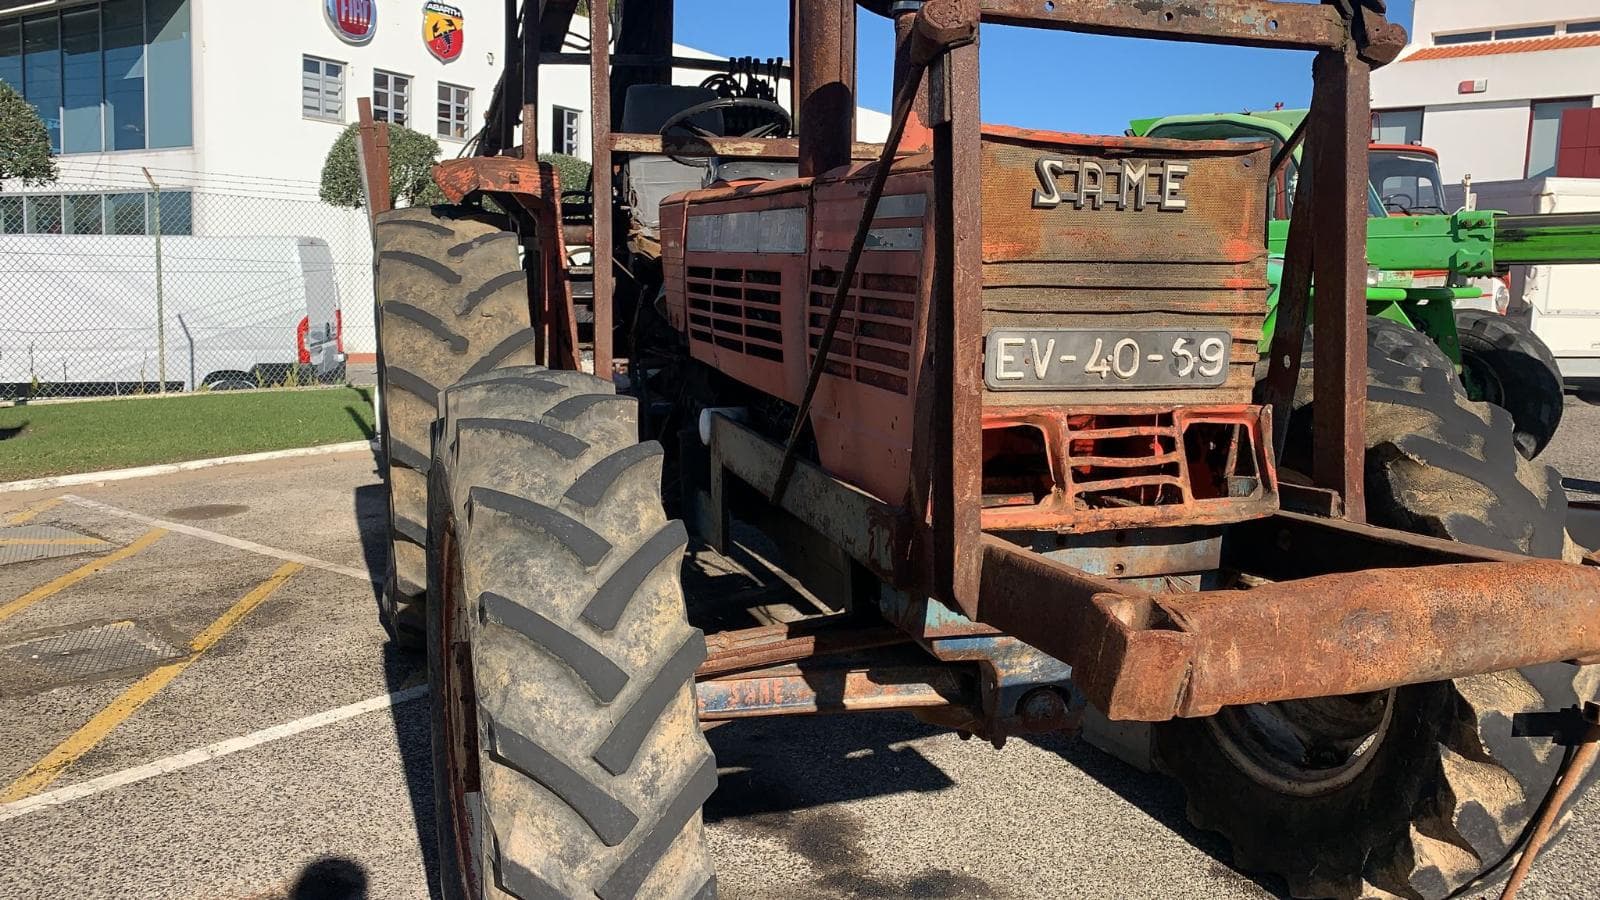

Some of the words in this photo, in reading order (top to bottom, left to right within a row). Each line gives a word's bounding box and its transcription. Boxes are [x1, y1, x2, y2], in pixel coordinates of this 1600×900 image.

[340, 0, 370, 27] FIAT
[426, 3, 462, 17] ABARTH
[1032, 157, 1189, 210] SAME
[996, 337, 1225, 380] EV-40-59
